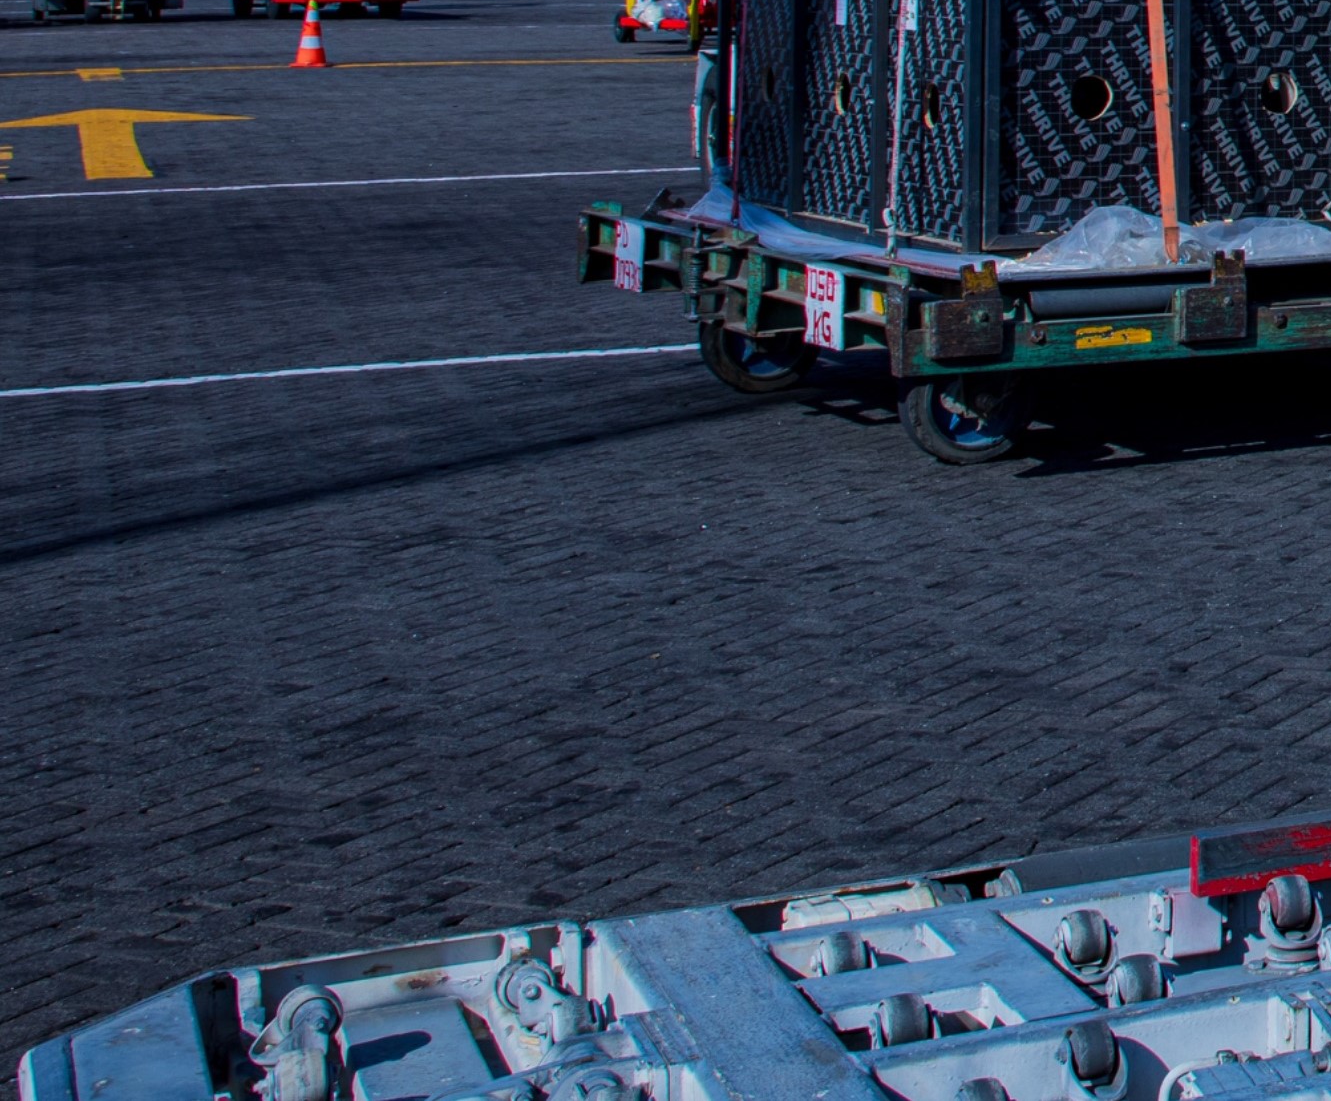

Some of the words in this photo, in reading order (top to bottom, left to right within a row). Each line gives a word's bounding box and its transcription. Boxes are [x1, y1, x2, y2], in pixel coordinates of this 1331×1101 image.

[1048, 72, 1097, 151] THRIVE
[1101, 40, 1148, 118] THRIVE
[1022, 89, 1072, 168] THRIVE
[1209, 117, 1255, 193] THRIVE
[1236, 101, 1281, 176] THRIVE
